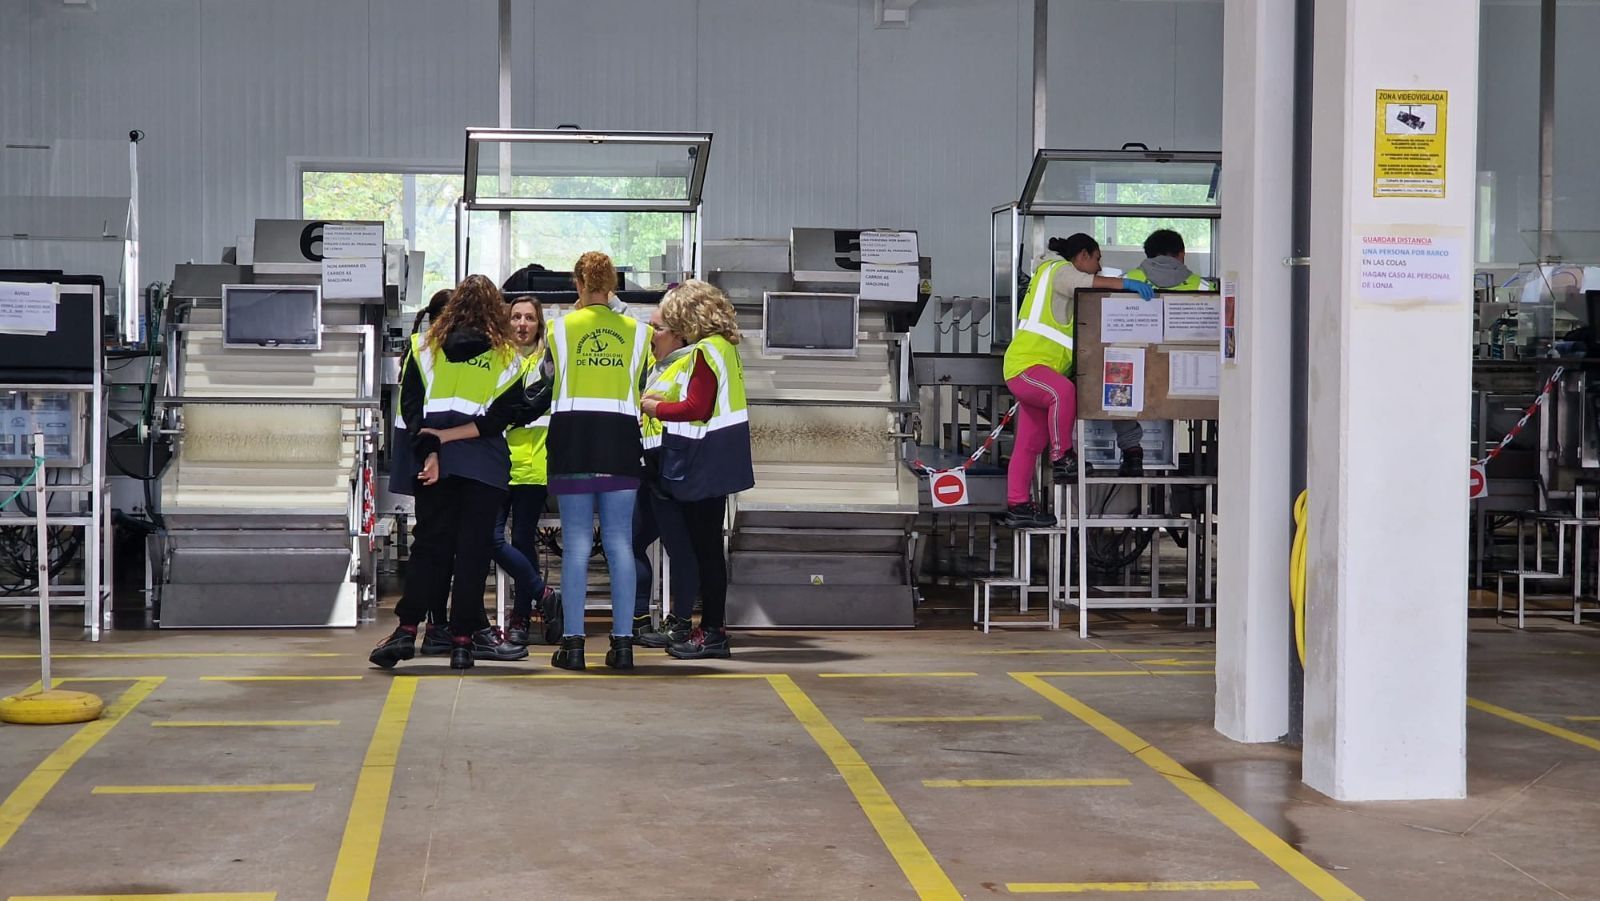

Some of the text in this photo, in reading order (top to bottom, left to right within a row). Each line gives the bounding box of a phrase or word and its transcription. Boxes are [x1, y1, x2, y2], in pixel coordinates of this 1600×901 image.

[1379, 92, 1444, 101] ZONA VIDEOVIGILADA
[1362, 236, 1396, 244] GUARDAR
[1379, 248, 1410, 256] PERSONA
[1426, 249, 1449, 257] BARCO
[1362, 258, 1372, 266] EN
[1385, 259, 1407, 267] COLAS
[1416, 272, 1451, 280] PERSONAL
[1361, 281, 1371, 289] DE
[467, 357, 491, 371] OIA
[588, 357, 624, 367] NOIA
